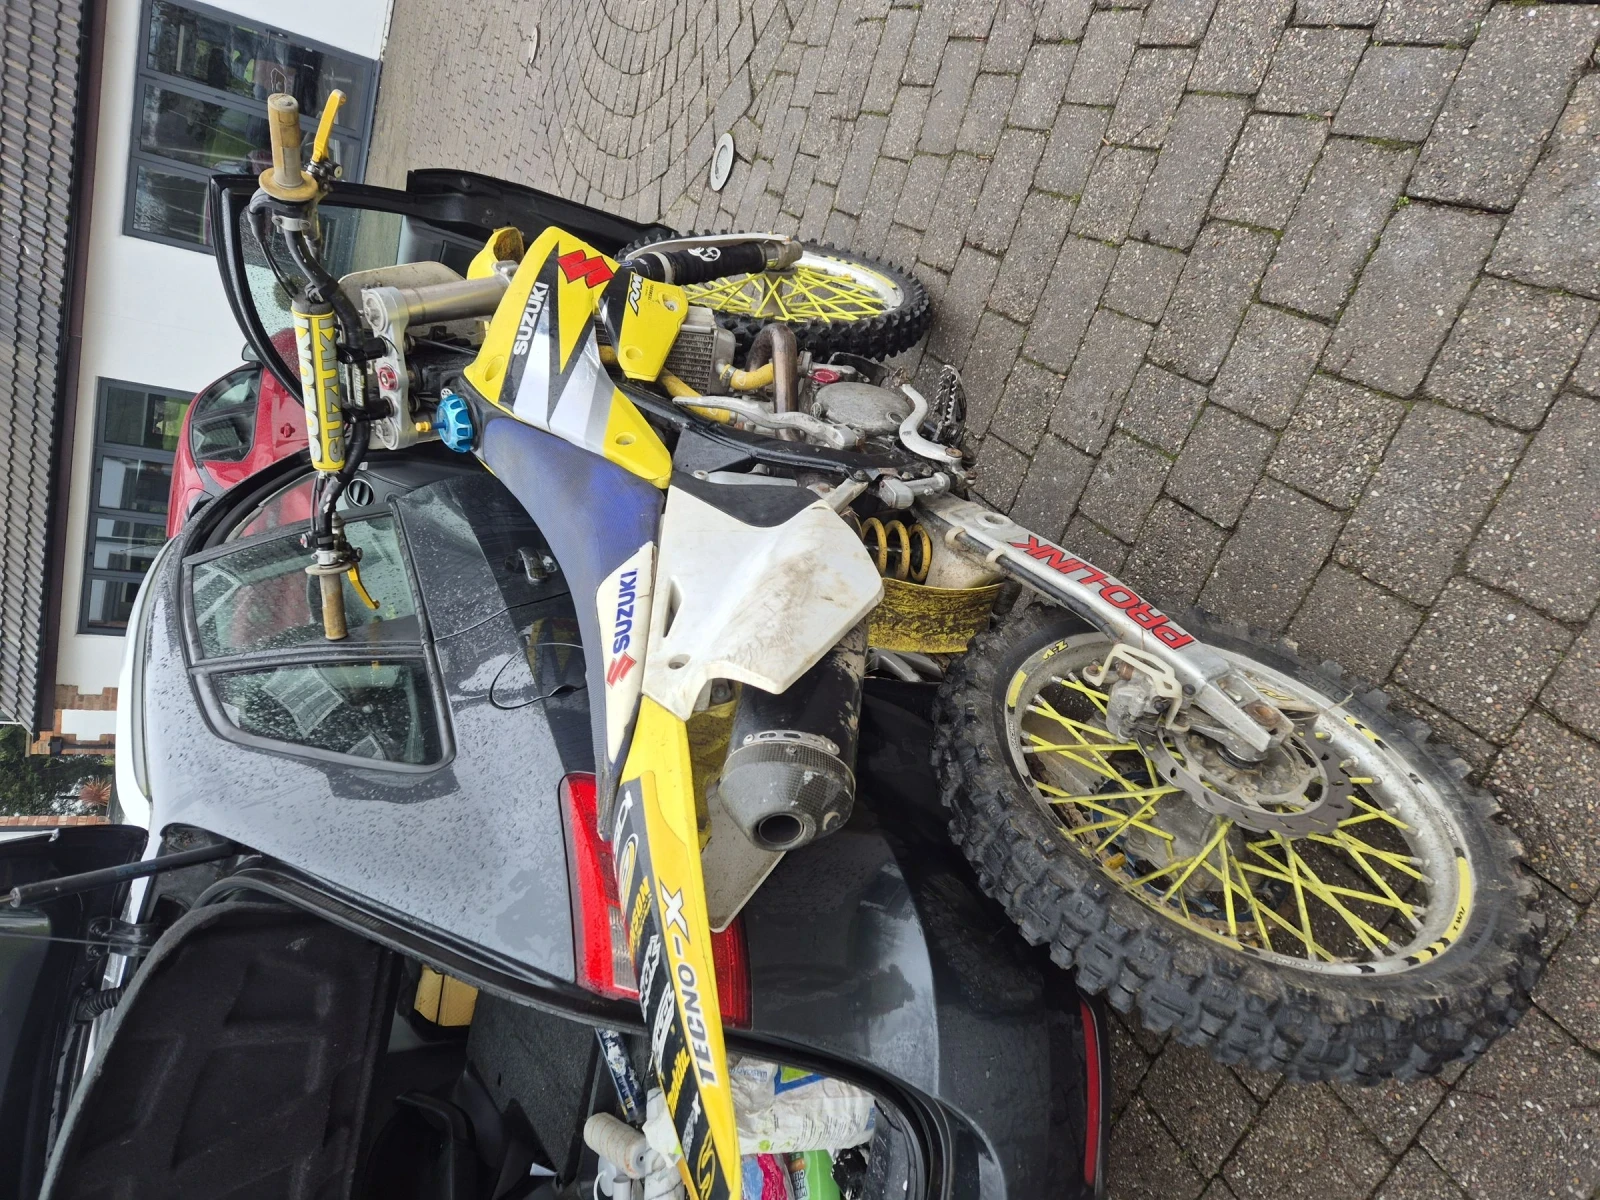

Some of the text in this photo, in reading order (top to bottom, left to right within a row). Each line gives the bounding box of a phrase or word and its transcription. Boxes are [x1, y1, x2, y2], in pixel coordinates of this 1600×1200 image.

[514, 281, 549, 356] SUZUKI
[628, 274, 643, 316] RM
[319, 318, 345, 463] SUZUKI
[612, 569, 638, 655] SUZUKI
[1007, 534, 1195, 650] PRO-LINK
[658, 877, 719, 1088] TECNO-X
